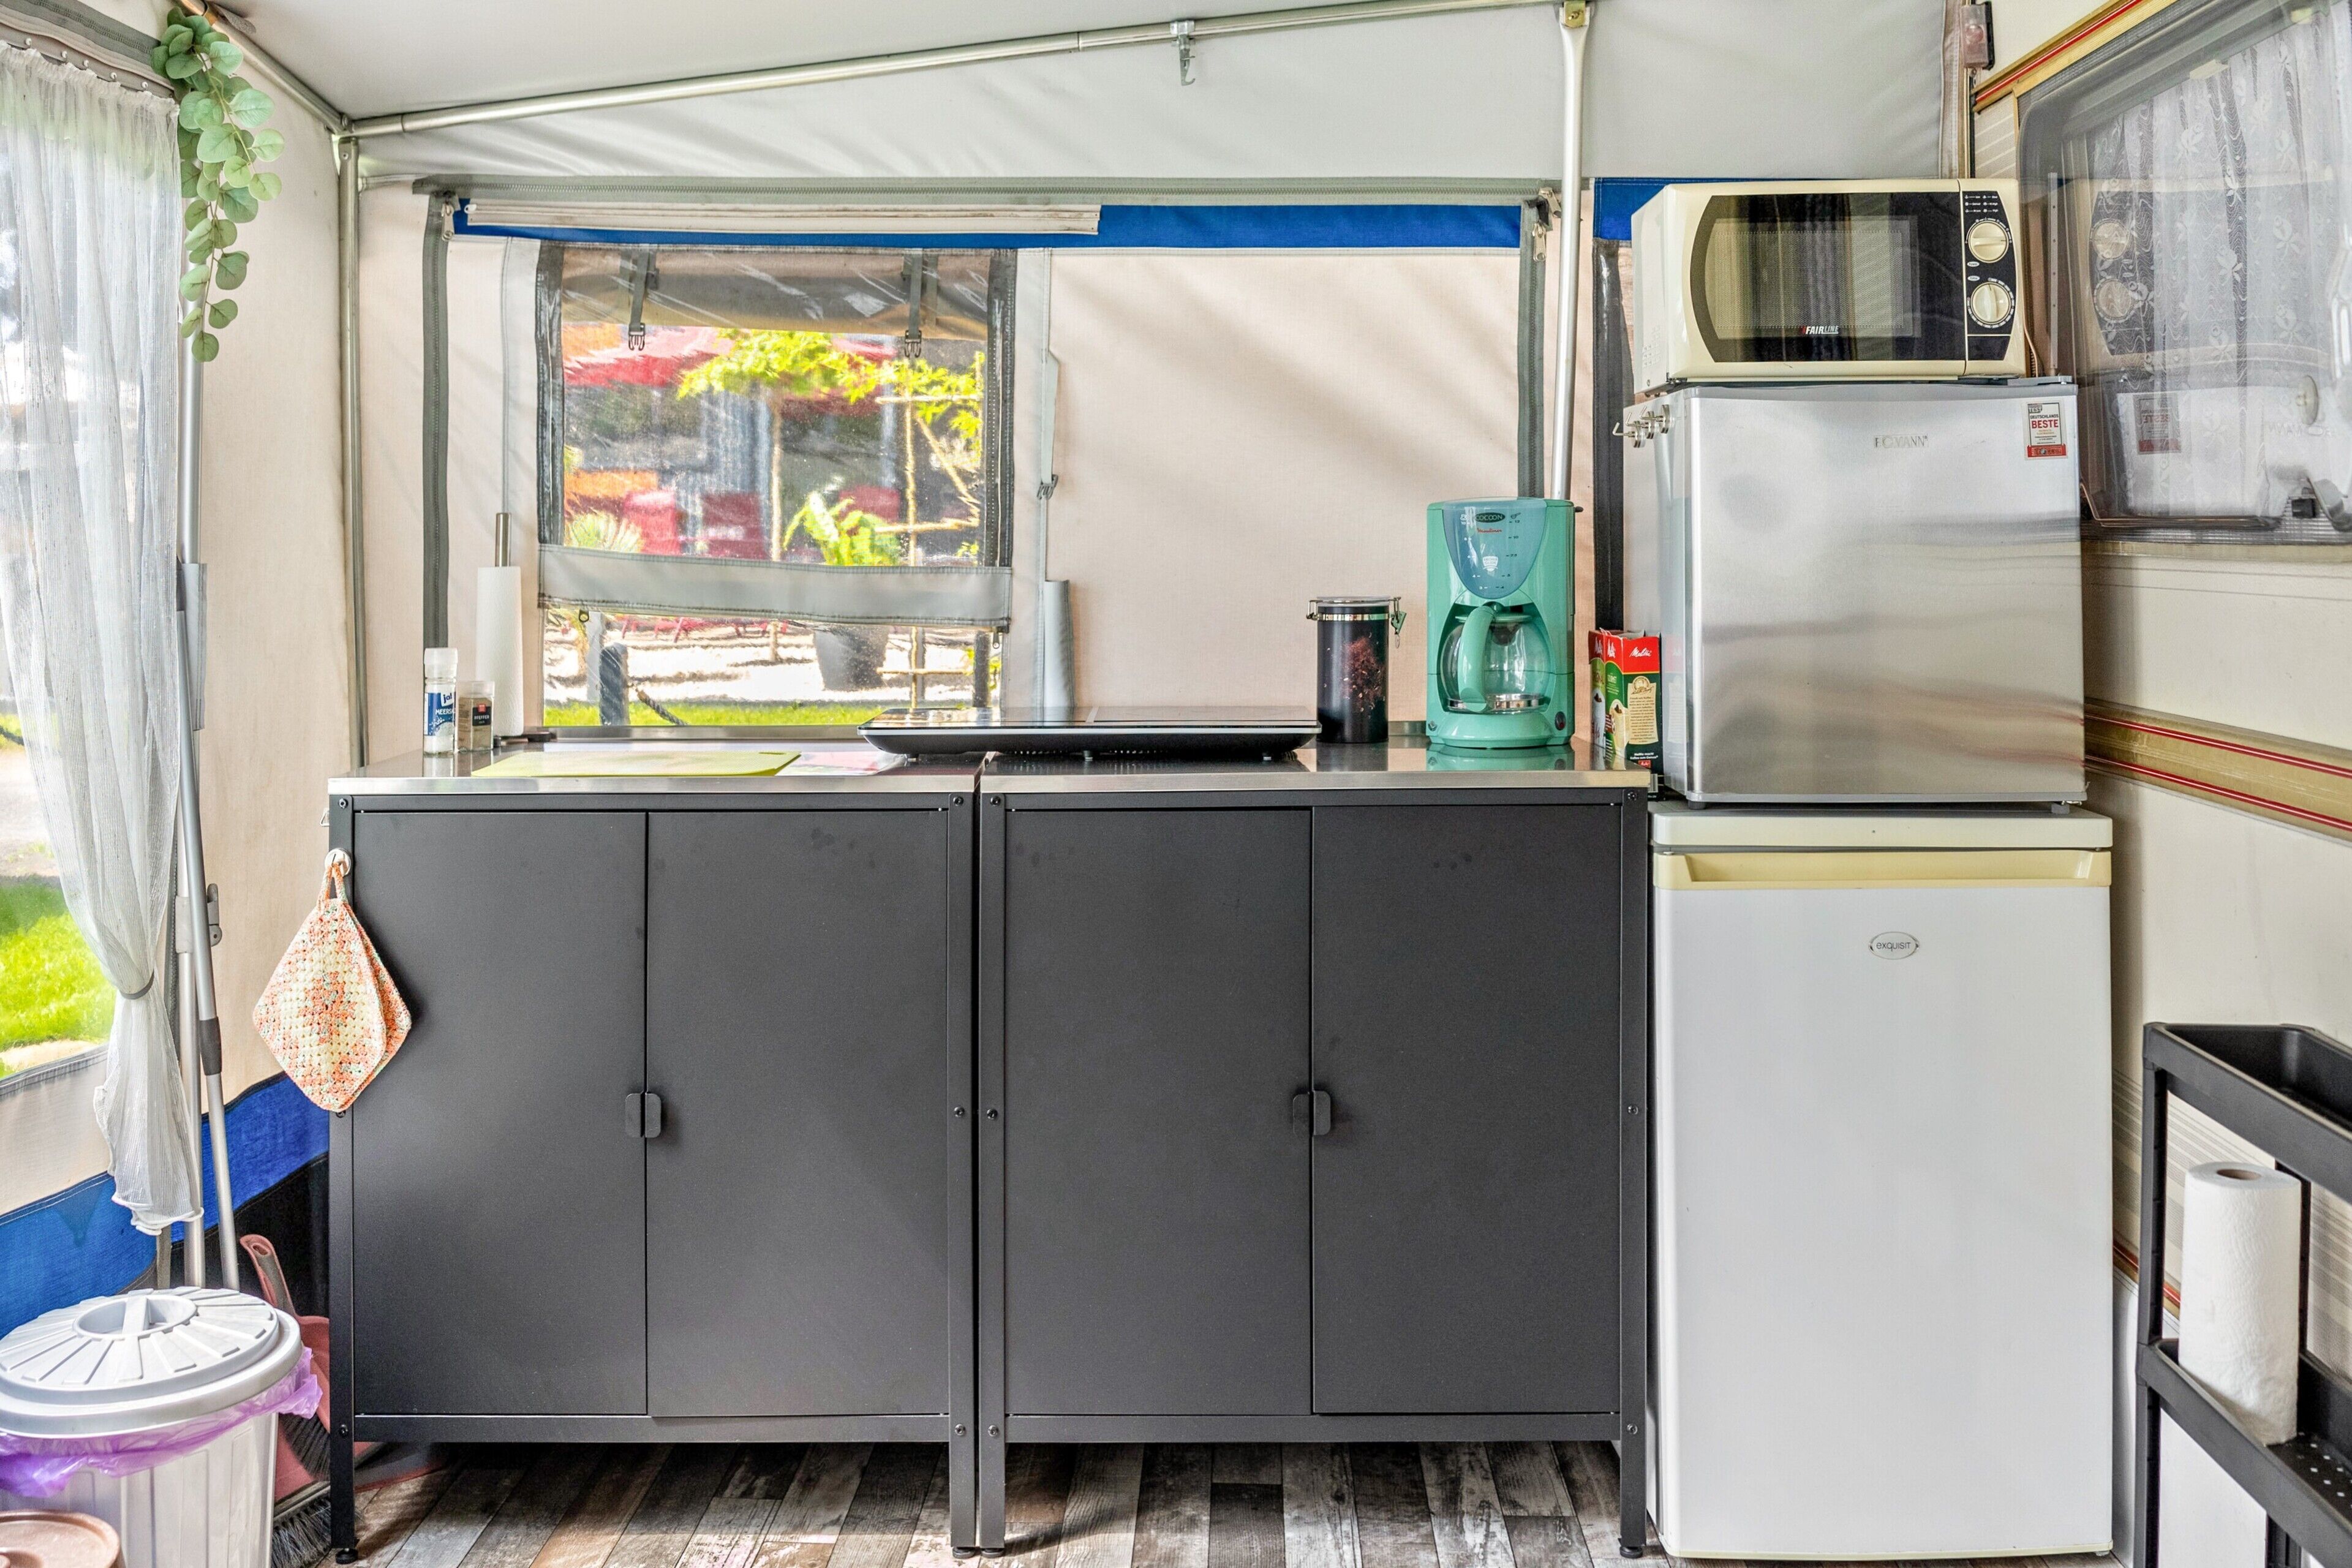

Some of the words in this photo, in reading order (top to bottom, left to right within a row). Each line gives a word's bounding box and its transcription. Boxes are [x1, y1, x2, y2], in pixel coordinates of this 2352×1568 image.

[1805, 325, 1839, 334] FAIRLINE
[2032, 420, 2059, 428] BESTE
[1629, 647, 1652, 657] Melitta
[443, 693, 452, 704] ja!
